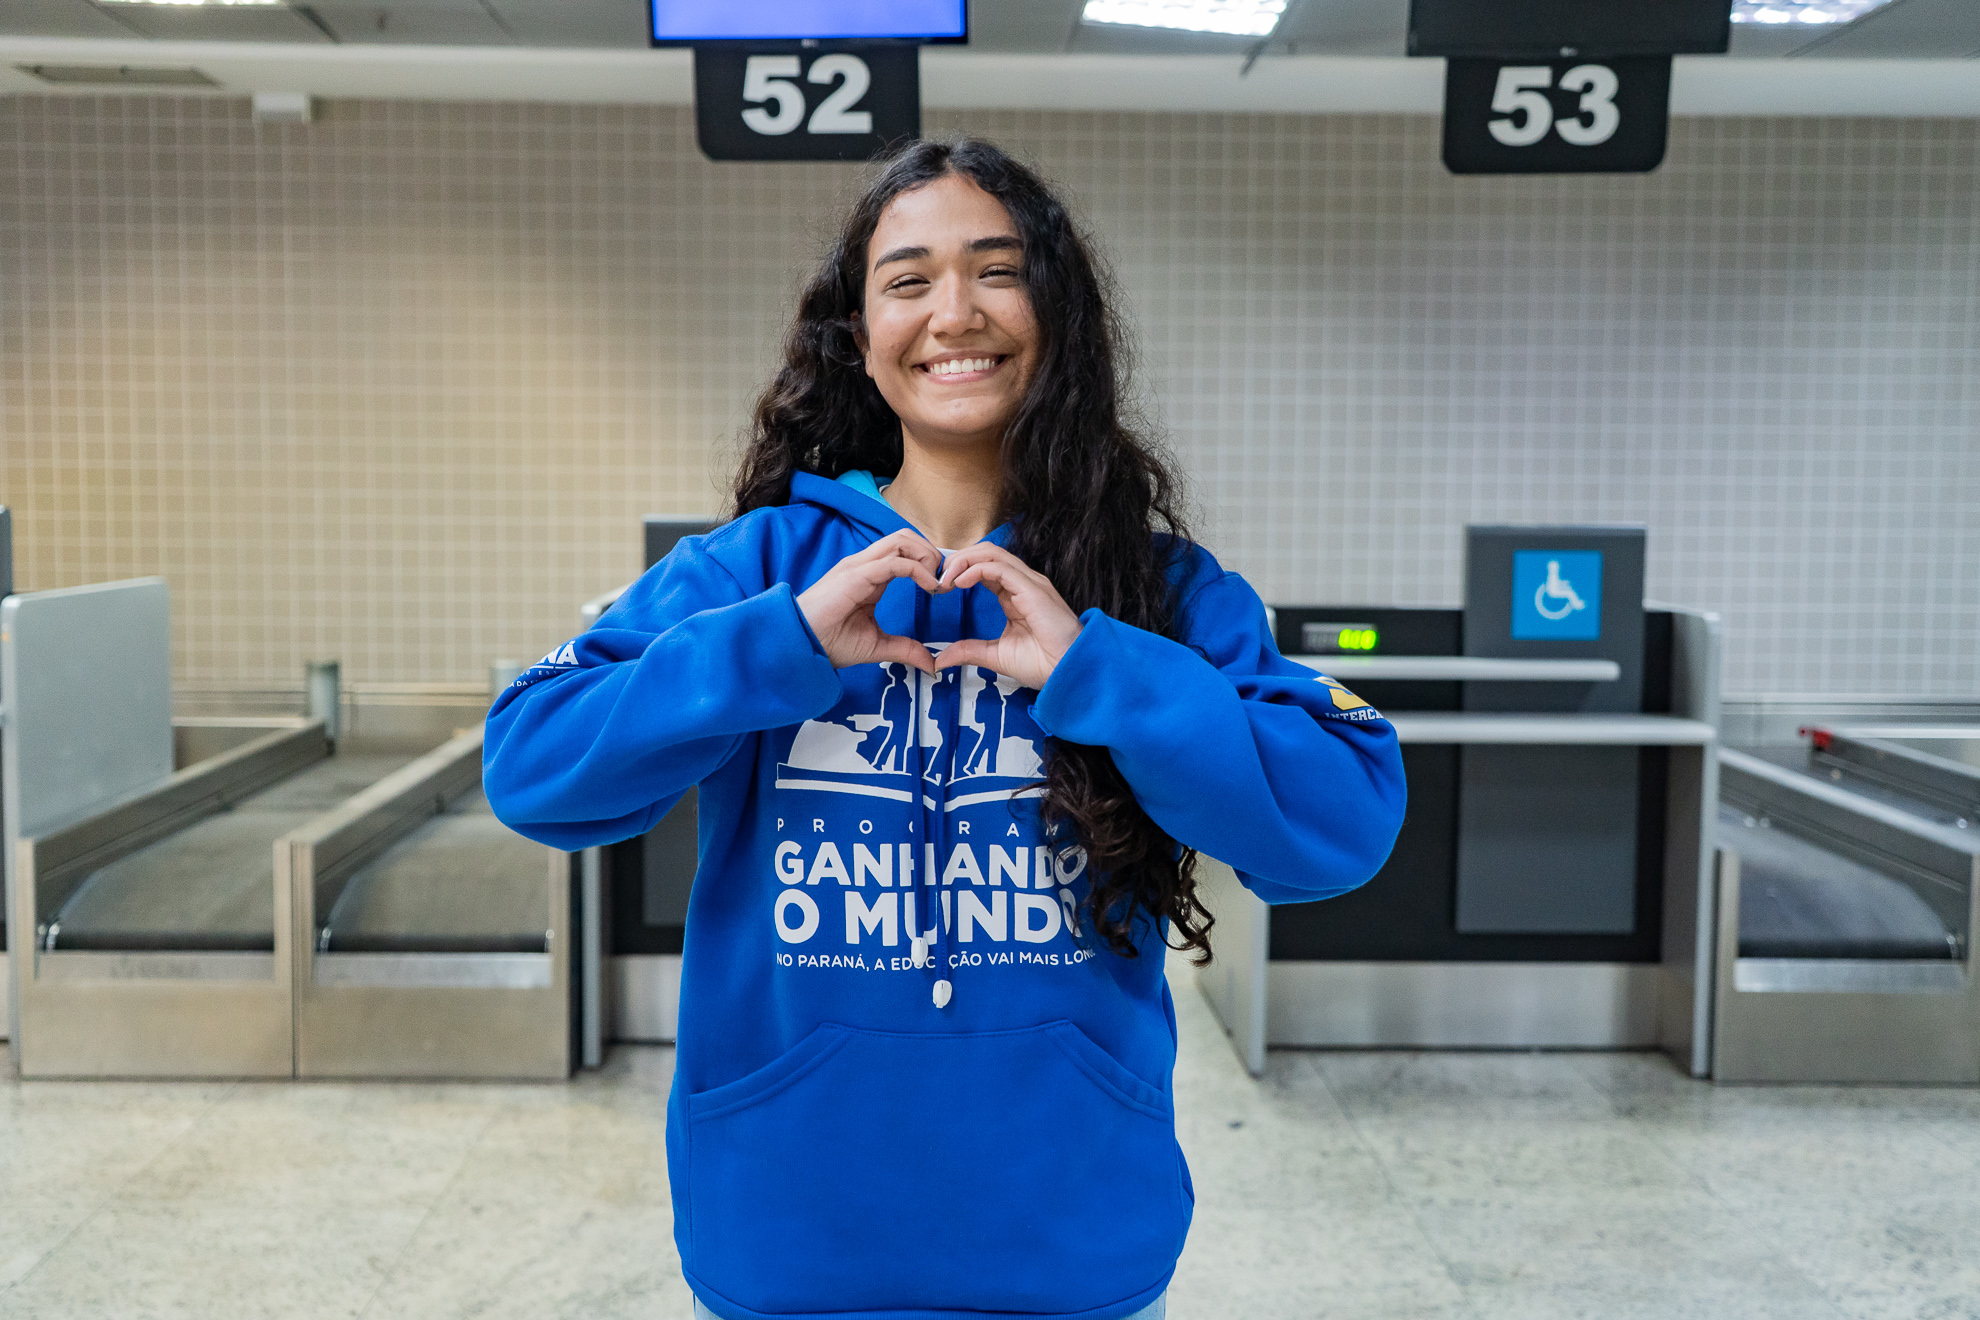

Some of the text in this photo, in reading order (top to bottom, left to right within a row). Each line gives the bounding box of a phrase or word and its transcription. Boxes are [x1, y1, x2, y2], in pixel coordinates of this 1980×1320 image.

[741, 54, 873, 135] 52
[1487, 64, 1620, 146] 53
[777, 818, 1060, 837] PRORAM
[775, 840, 1088, 889] GANHANDO
[774, 888, 820, 944] O
[777, 953, 793, 967] NO
[798, 953, 870, 972] PARANÁ,
[874, 958, 885, 970] A
[891, 951, 982, 970] EDCÇÃO
[987, 951, 1014, 965] VAI
[1020, 951, 1059, 966] MAIS
